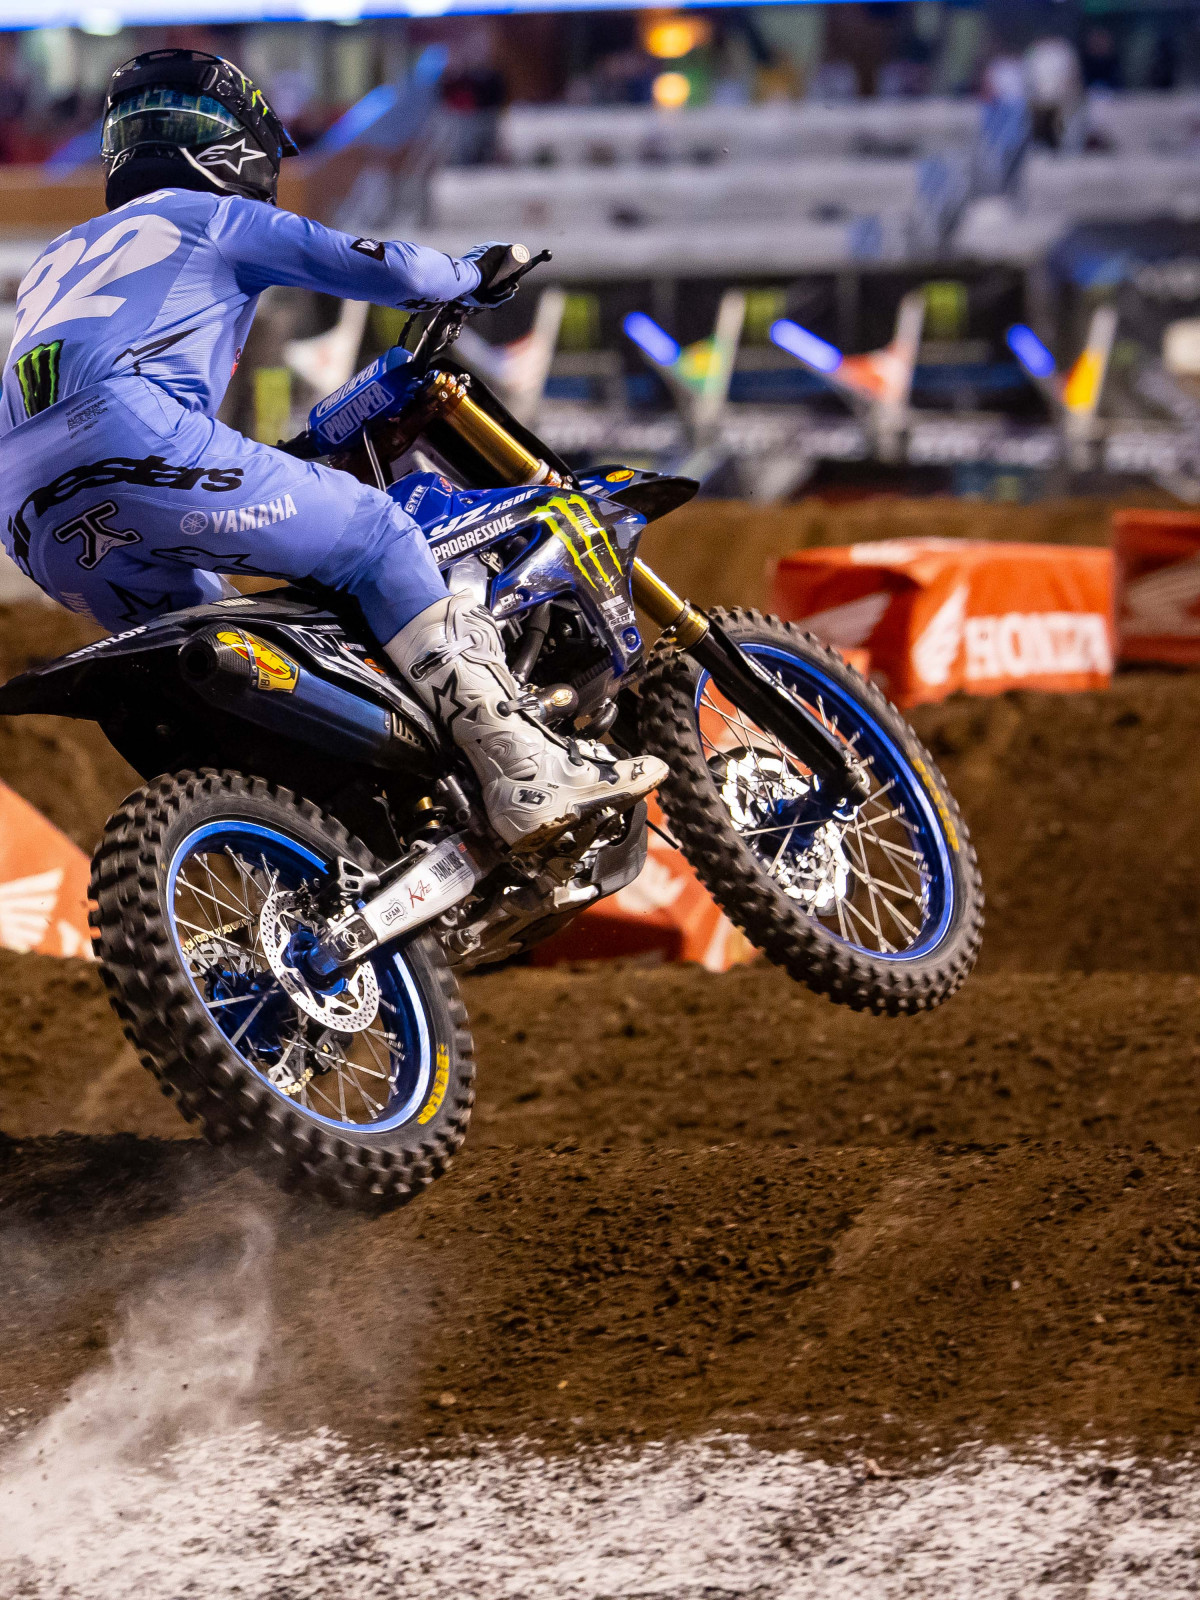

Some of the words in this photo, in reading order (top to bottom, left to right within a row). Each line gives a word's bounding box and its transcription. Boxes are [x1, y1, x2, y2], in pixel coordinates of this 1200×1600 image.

[6, 213, 183, 364] 32
[322, 385, 388, 441] PROTAPER
[211, 493, 297, 533] YAMAHA
[433, 513, 517, 563] PROGRESSIVE
[65, 625, 148, 659] DUNLOP
[384, 906, 401, 921] AFAM
